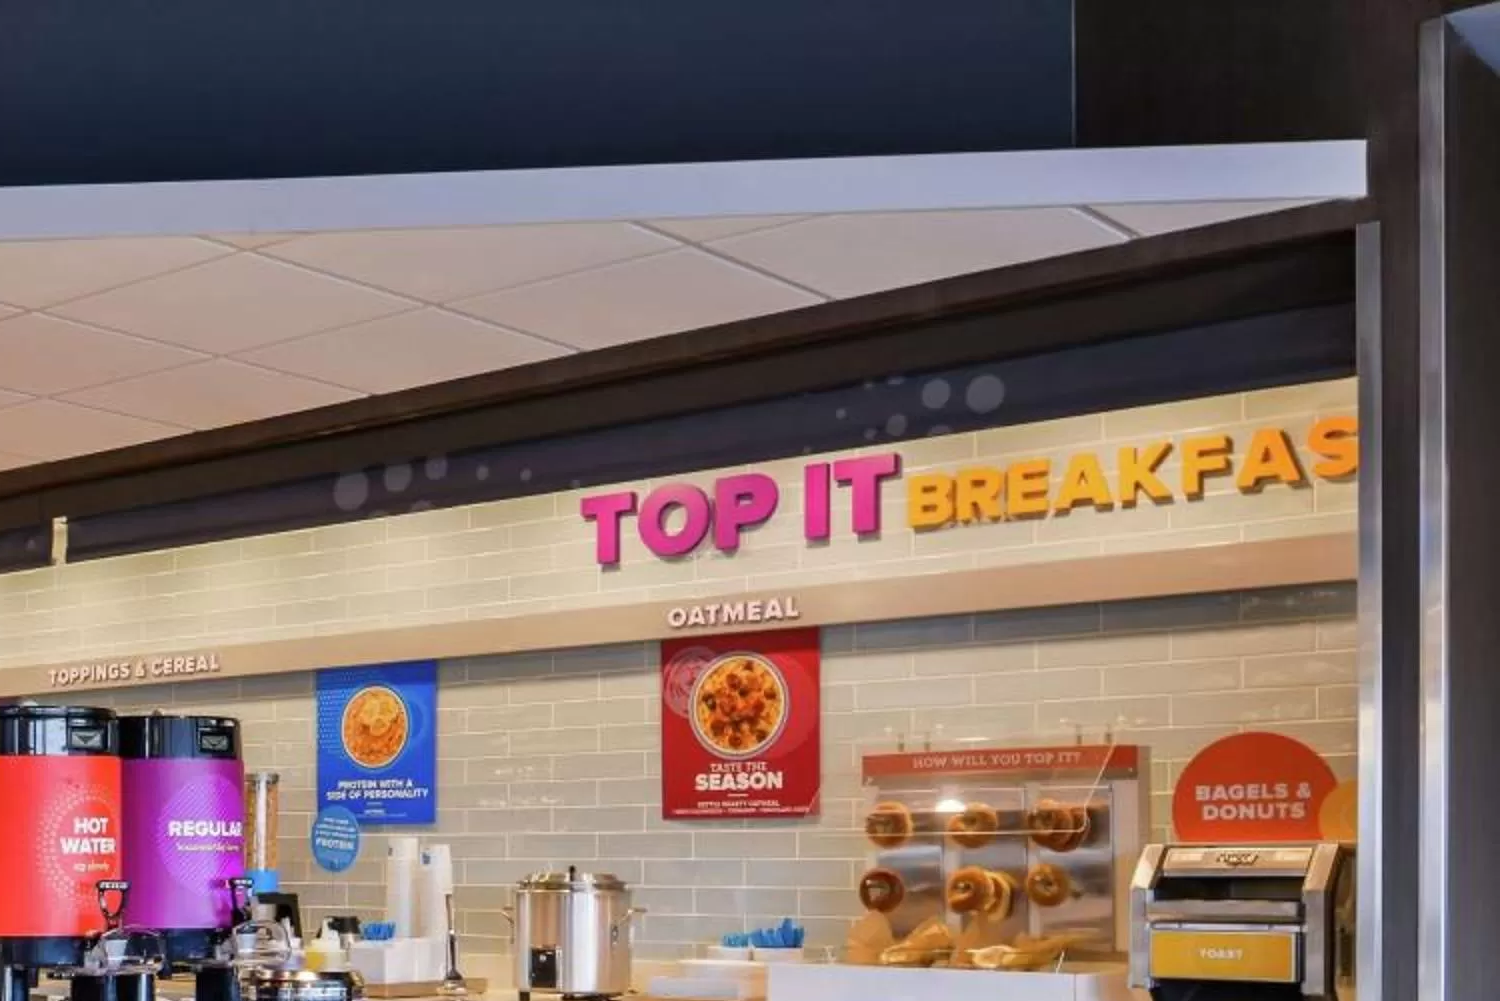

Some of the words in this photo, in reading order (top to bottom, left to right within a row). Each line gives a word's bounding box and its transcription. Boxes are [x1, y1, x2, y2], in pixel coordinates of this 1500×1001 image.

[581, 473, 779, 565] TOP
[804, 453, 901, 540] IT
[908, 415, 1358, 530] BREAKFAS
[668, 597, 799, 627] OATMEAL
[49, 663, 131, 686] TOPPINGS
[135, 659, 147, 678] &
[152, 653, 221, 676] CEREAL
[709, 763, 741, 773] TASTE
[746, 761, 768, 771] THE
[913, 755, 947, 769] HOW
[951, 754, 987, 767] WILL
[989, 752, 1021, 766] YOU
[1024, 752, 1054, 766] TOP
[1058, 751, 1081, 764] IT?
[338, 780, 377, 790] PROTEIN
[380, 779, 403, 789] WITH
[406, 778, 413, 788] A
[694, 771, 783, 791] SEASON
[348, 790, 361, 800] OF
[363, 787, 429, 800] PERSONALITY
[1195, 783, 1289, 802] BAGELS
[1296, 782, 1312, 800] &
[1202, 802, 1305, 821] DONUTS
[73, 817, 109, 834] HOT
[60, 837, 116, 855] WATER
